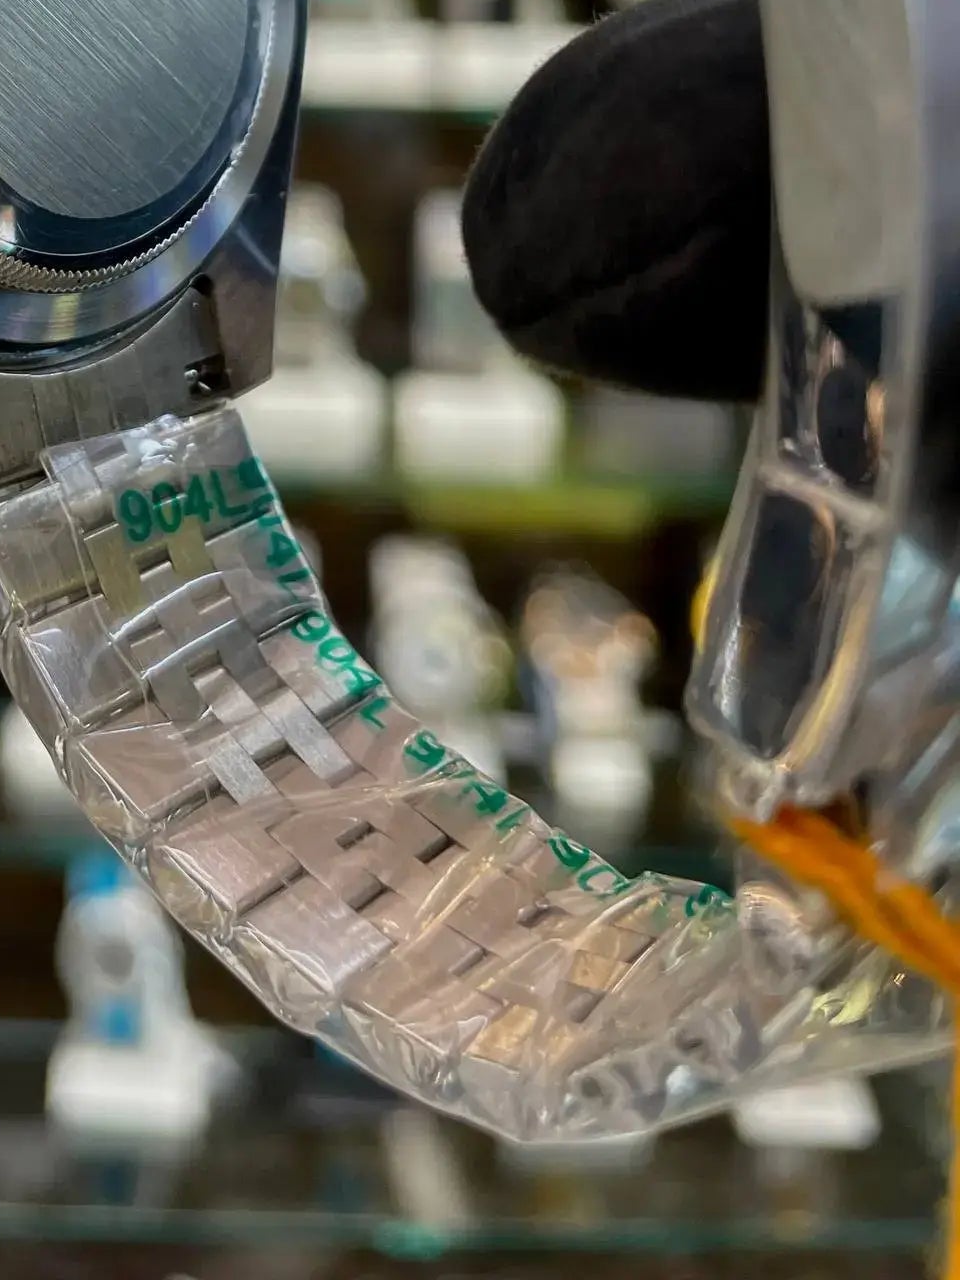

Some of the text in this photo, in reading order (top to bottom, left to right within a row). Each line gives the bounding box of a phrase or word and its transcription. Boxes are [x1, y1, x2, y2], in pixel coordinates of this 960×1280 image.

[119, 469, 248, 543] 904L
[290, 609, 390, 730] 904L
[404, 728, 533, 835] 94L
